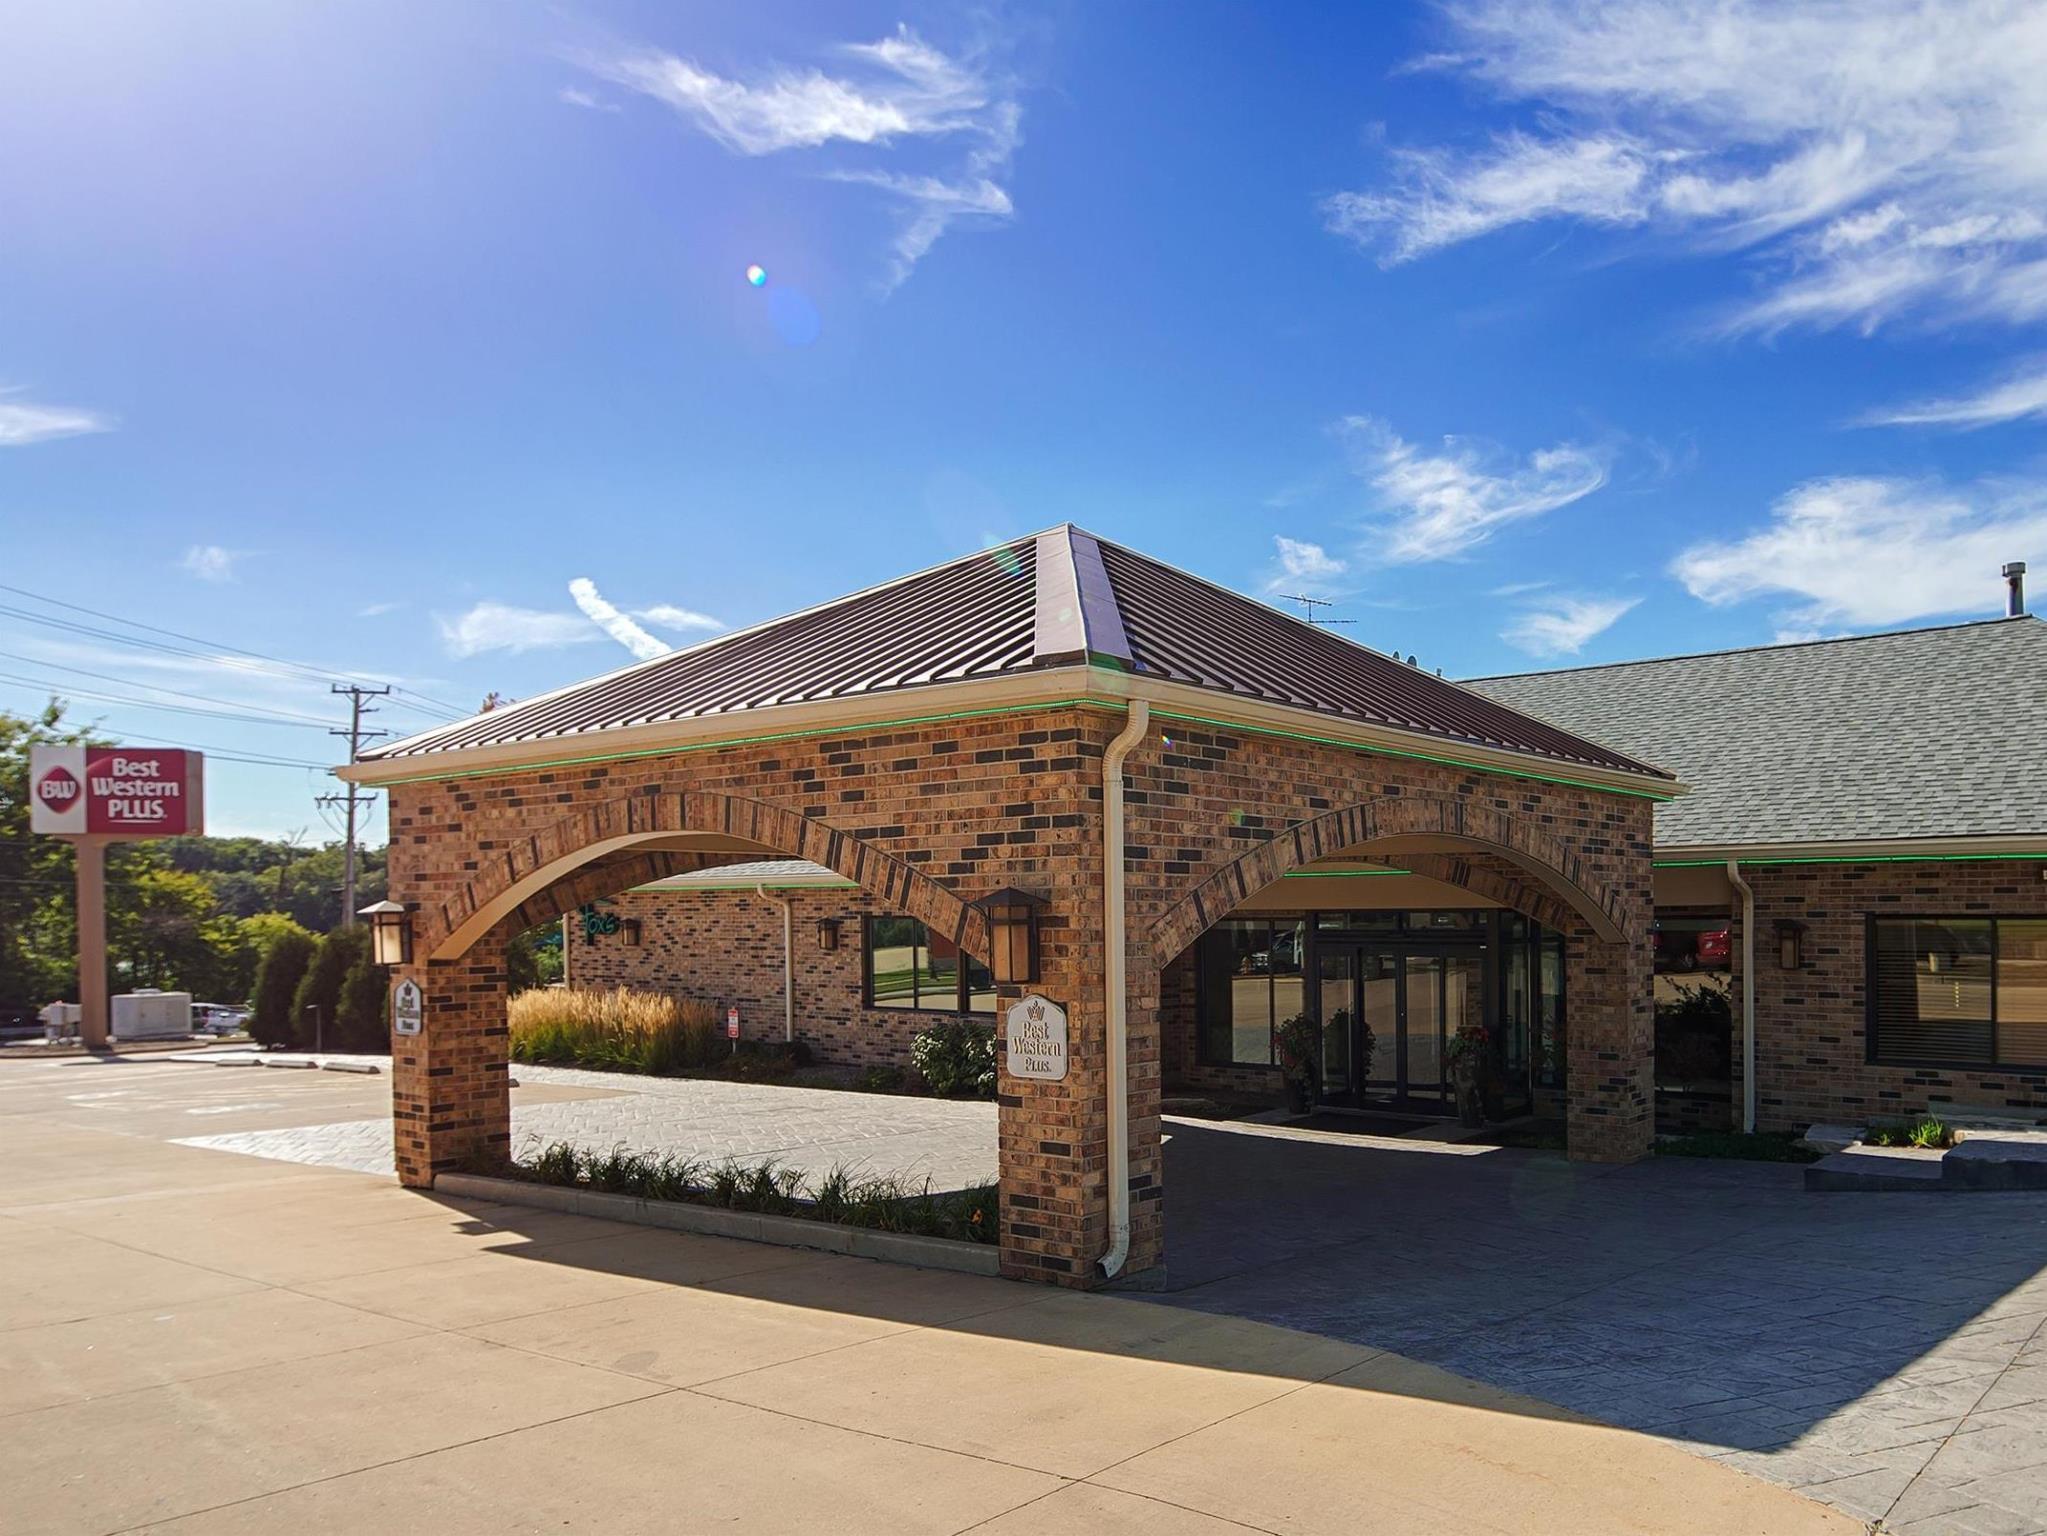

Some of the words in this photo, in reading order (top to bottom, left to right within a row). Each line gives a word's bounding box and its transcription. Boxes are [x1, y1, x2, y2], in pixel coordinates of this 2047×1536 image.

[111, 758, 160, 777] Best
[41, 780, 76, 799] BW
[92, 778, 179, 796] Western
[108, 799, 165, 818] PLUS
[1023, 1021, 1049, 1040] Best
[1012, 1036, 1061, 1056] Western
